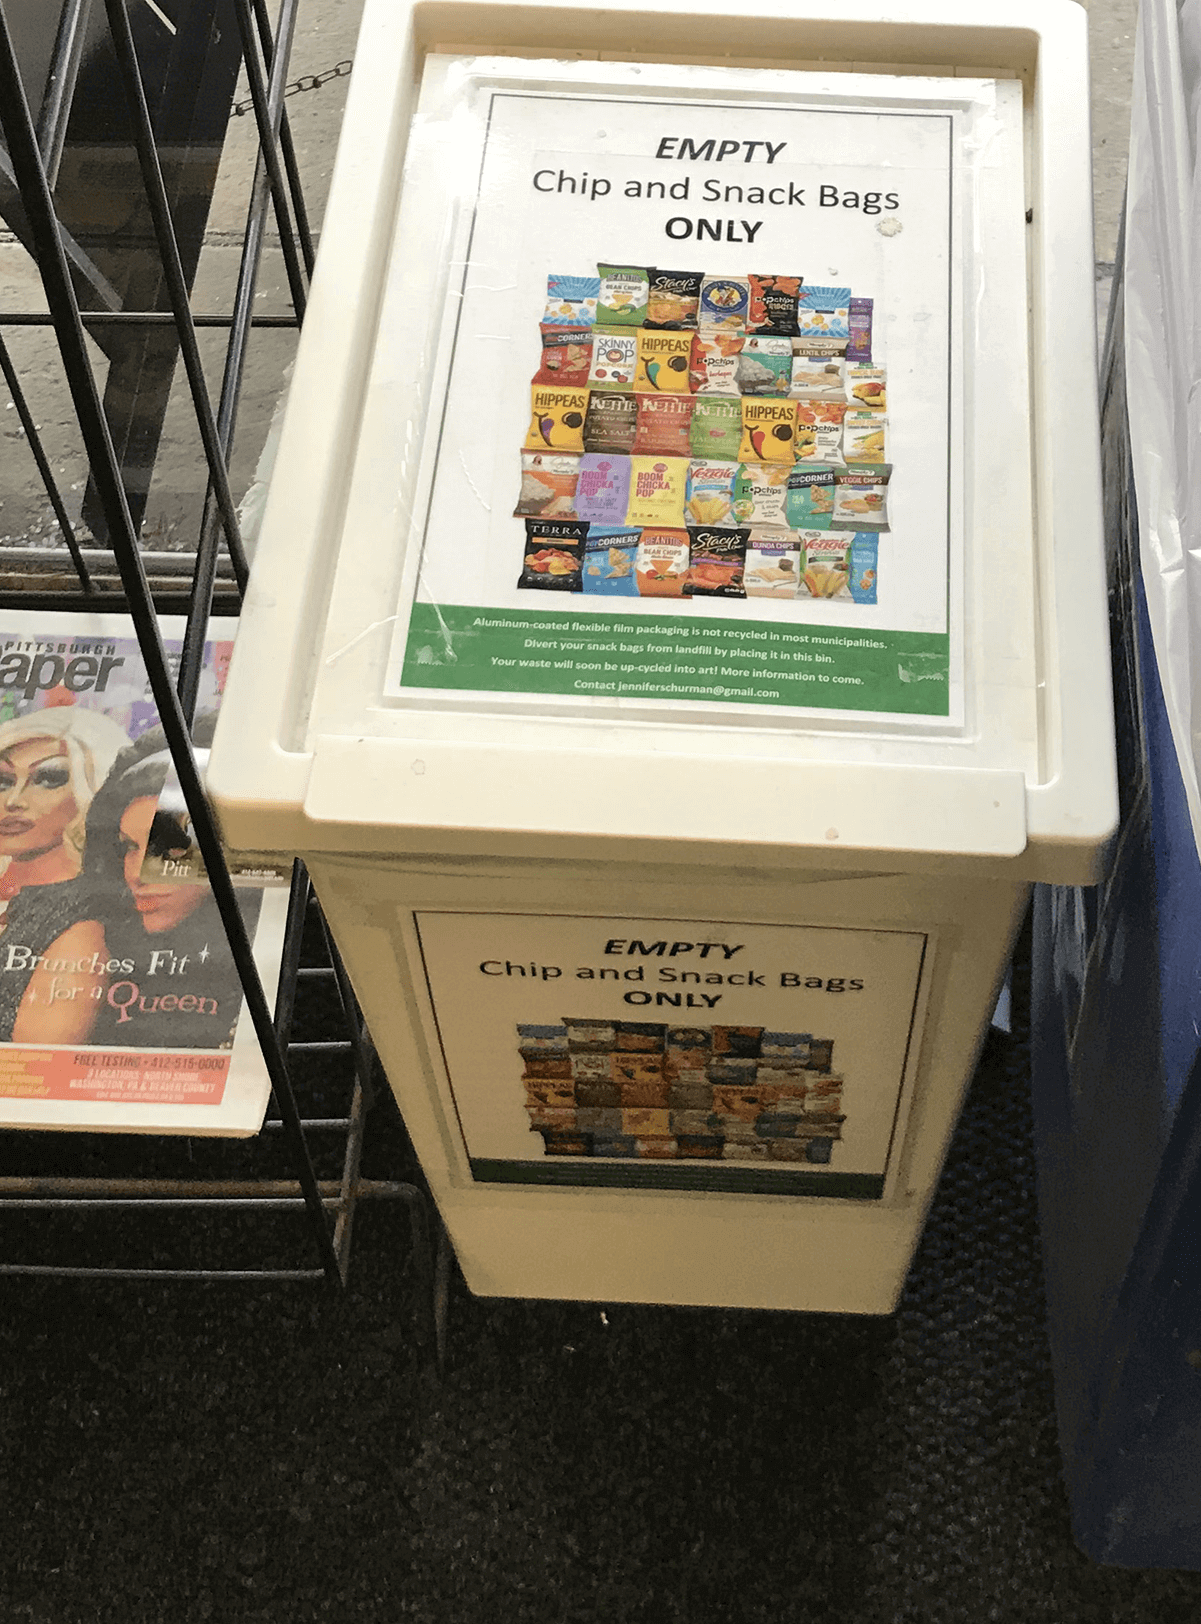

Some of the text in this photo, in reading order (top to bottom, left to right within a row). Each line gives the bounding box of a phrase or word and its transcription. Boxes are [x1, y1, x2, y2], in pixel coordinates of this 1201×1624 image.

[655, 136, 788, 164] EMPTY
[532, 169, 900, 215] Chip and Snack Bags
[664, 216, 763, 243] ONLY
[650, 276, 697, 292] Stacy's
[598, 337, 635, 349] SKINNY
[642, 337, 690, 352] HIPPEAS
[597, 347, 635, 363] POP
[696, 358, 735, 366] popchips
[535, 393, 586, 409] HIPPEAS
[745, 405, 794, 421] HIPPEAS
[799, 424, 840, 432] popchips
[637, 472, 664, 481] BOOM
[839, 476, 883, 484] VEGGIE CHIPS
[636, 481, 670, 490] CHICKA
[636, 489, 655, 497] POP
[741, 486, 782, 495] popchips
[530, 525, 582, 535] TERRA
[691, 533, 743, 551] Stacy's
[776, 542, 794, 550] CHIPS
[803, 538, 850, 551] Veggie
[473, 617, 888, 649] Aluminum-coated flexible film packaging is not recycled in most municipalities.
[5, 641, 117, 656] PITTSBURGH
[524, 639, 836, 663] Divert your snack bags from landfill by placing it in this bin.
[0, 652, 125, 700] aper
[491, 656, 865, 686] Your waste will soon be up-cycled into art! More information to come.
[574, 679, 780, 698] Contact jenniferschurman@gmail.com
[604, 938, 746, 960] EMPTY
[4, 944, 190, 976] Brunches Fit
[479, 960, 866, 993] Chip and Snack Bags
[49, 976, 219, 1024] for a Queen
[623, 990, 723, 1009] ONLY
